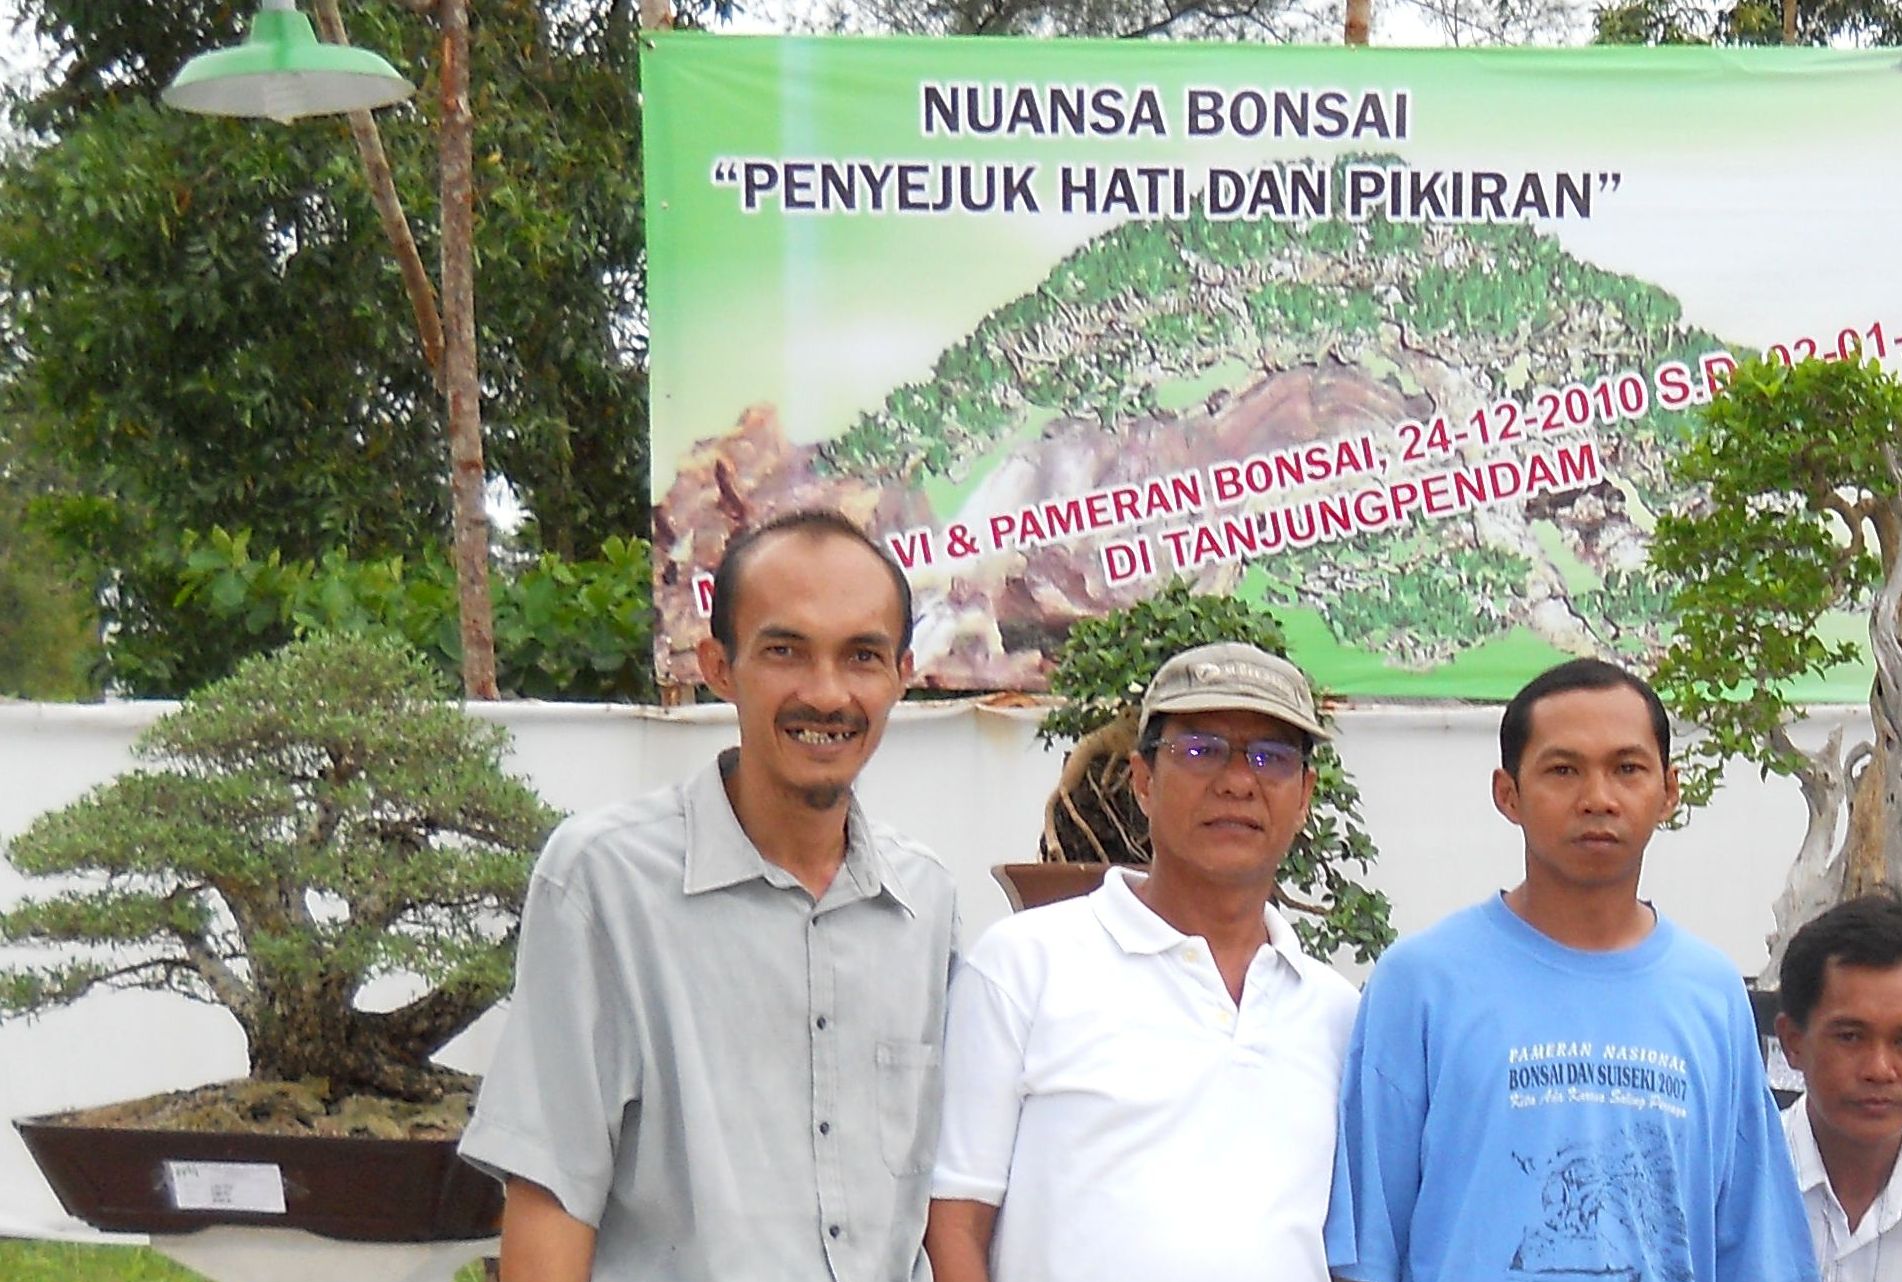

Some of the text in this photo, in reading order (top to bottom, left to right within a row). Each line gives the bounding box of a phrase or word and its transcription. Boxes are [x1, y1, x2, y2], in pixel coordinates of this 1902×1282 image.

[923, 86, 1407, 139] NUANSA BONSAI
[714, 161, 1622, 219] “PENYEJUK HATI DAN PIKIRAN”
[947, 523, 980, 558] &
[989, 474, 1202, 550] PAMERAN
[1213, 436, 1388, 501] BONSAI,
[1399, 376, 1644, 463] 24-12-2010
[1105, 443, 1598, 582] DI TANJUNGPENDAM
[1508, 1041, 1687, 1074] PAMERAN NASIONAL
[1508, 1062, 1688, 1102] BONSAI DAN SUISEKI 2007
